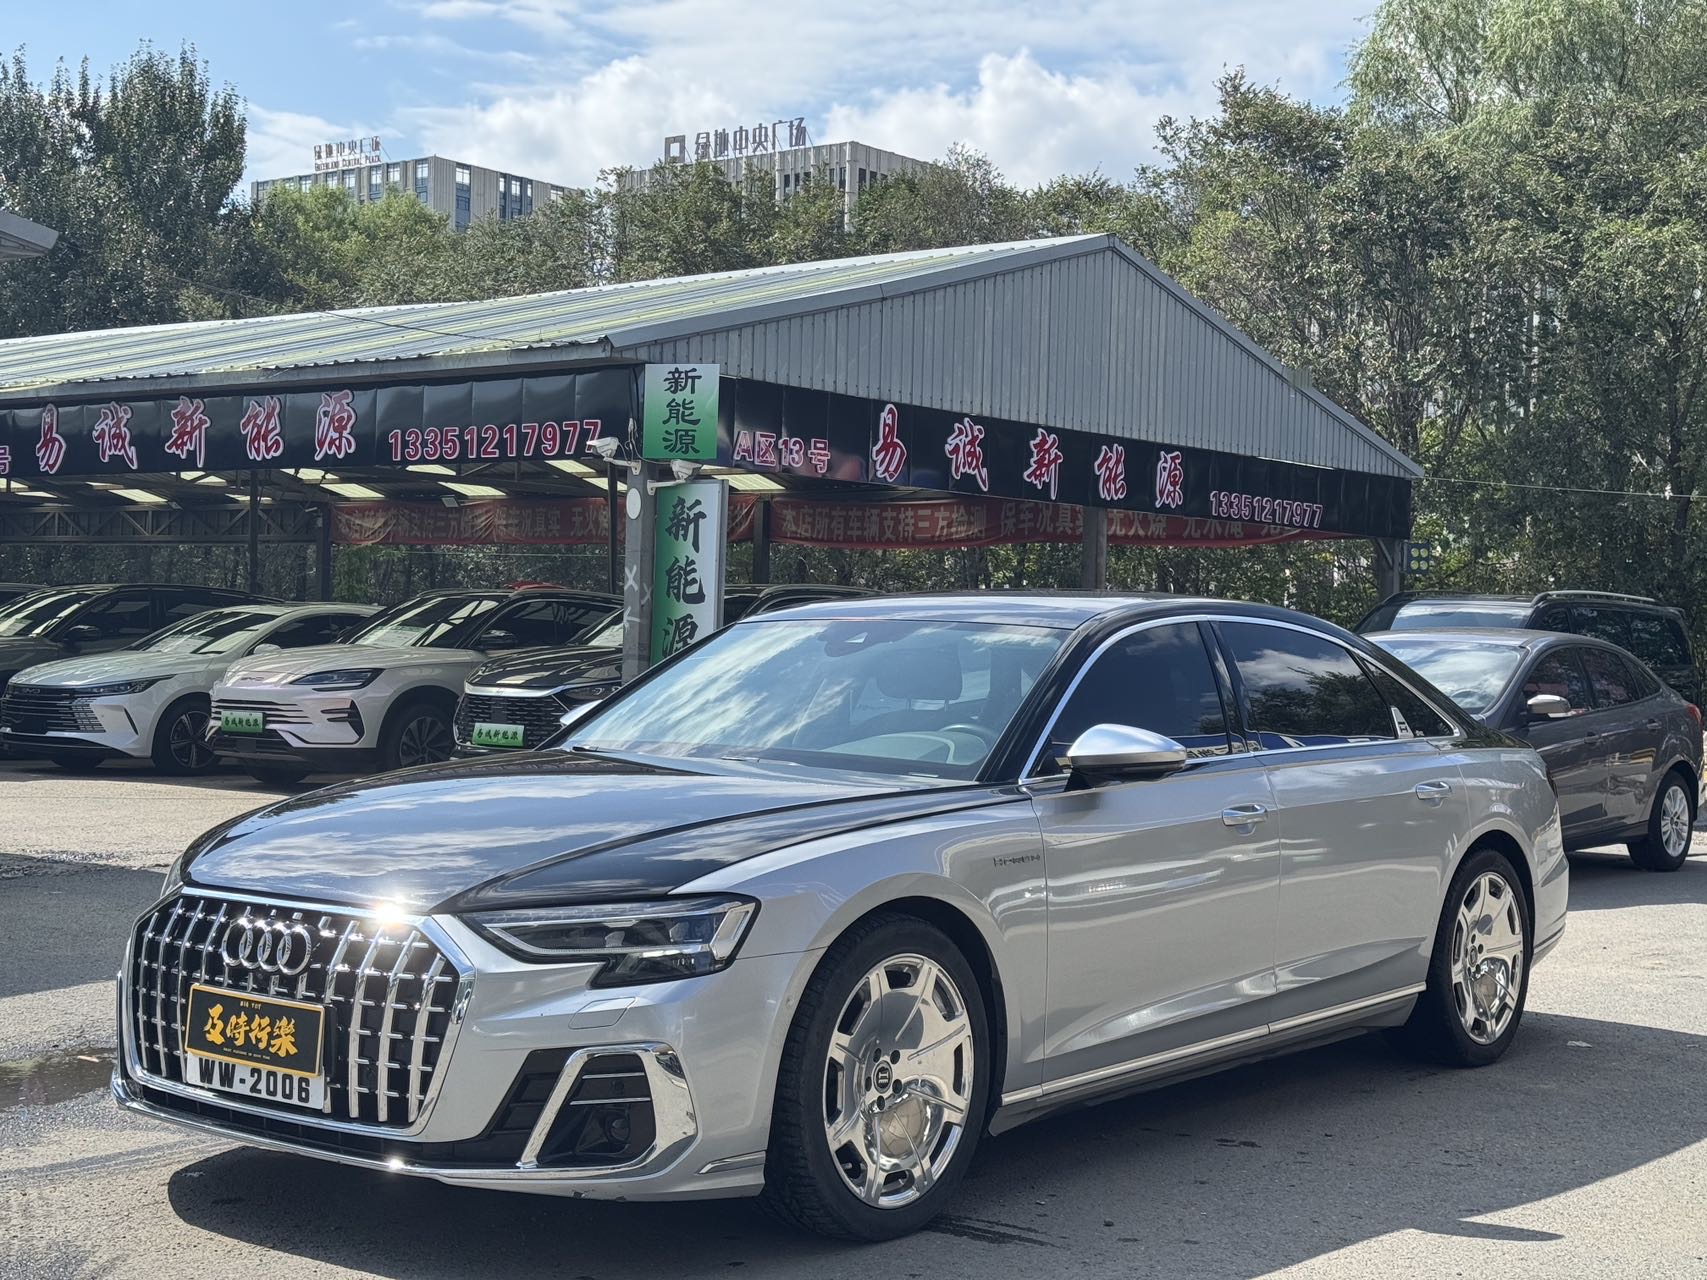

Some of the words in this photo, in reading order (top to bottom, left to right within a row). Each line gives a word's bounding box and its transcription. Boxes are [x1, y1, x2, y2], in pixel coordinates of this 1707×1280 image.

[36, 389, 357, 475] 易诚新能源
[388, 420, 601, 462] 13351217977
[662, 367, 702, 455] 新能源
[733, 431, 831, 473] A区13号
[872, 403, 1184, 508] 易诚新能源
[1210, 490, 1323, 528] 13351217977
[662, 495, 707, 659] 新能源
[203, 1003, 299, 1058] 及時行樂
[198, 1057, 311, 1104] WW-2006
